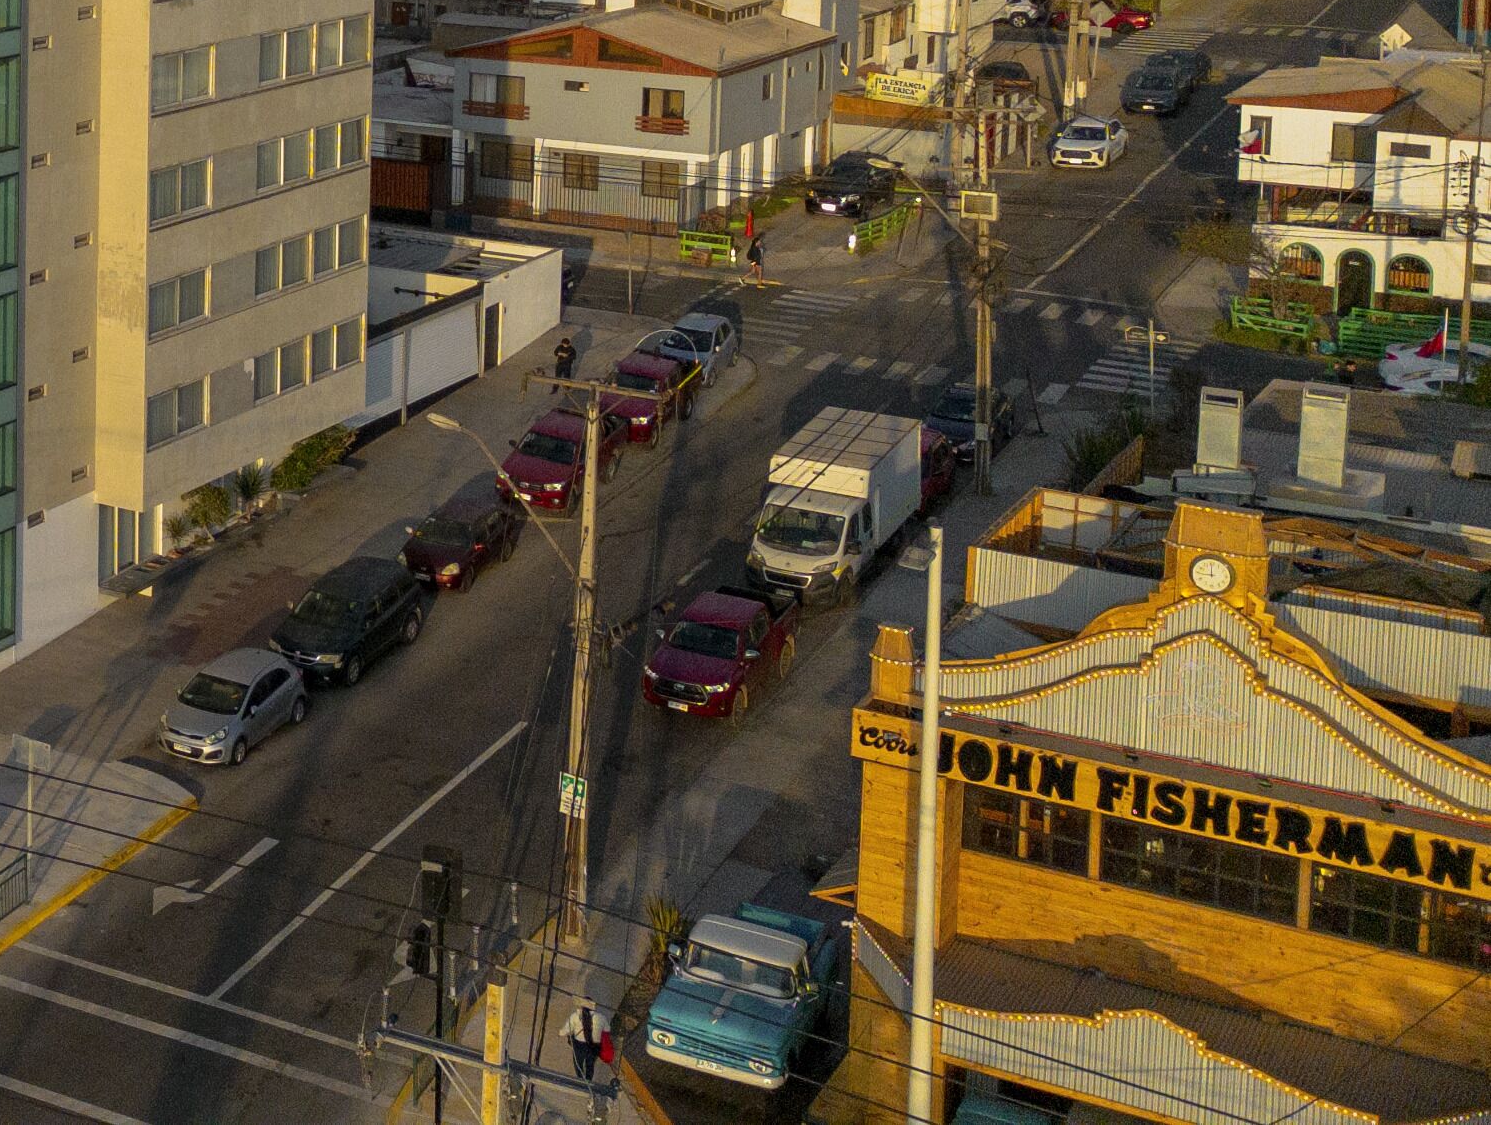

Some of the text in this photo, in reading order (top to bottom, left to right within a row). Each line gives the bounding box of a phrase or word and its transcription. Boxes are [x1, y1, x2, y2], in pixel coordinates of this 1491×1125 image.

[881, 84, 891, 92] DE
[890, 79, 926, 91] ESTANCIA
[859, 725, 919, 757] Coors
[937, 730, 1476, 891] JOHN FISHERMAN
